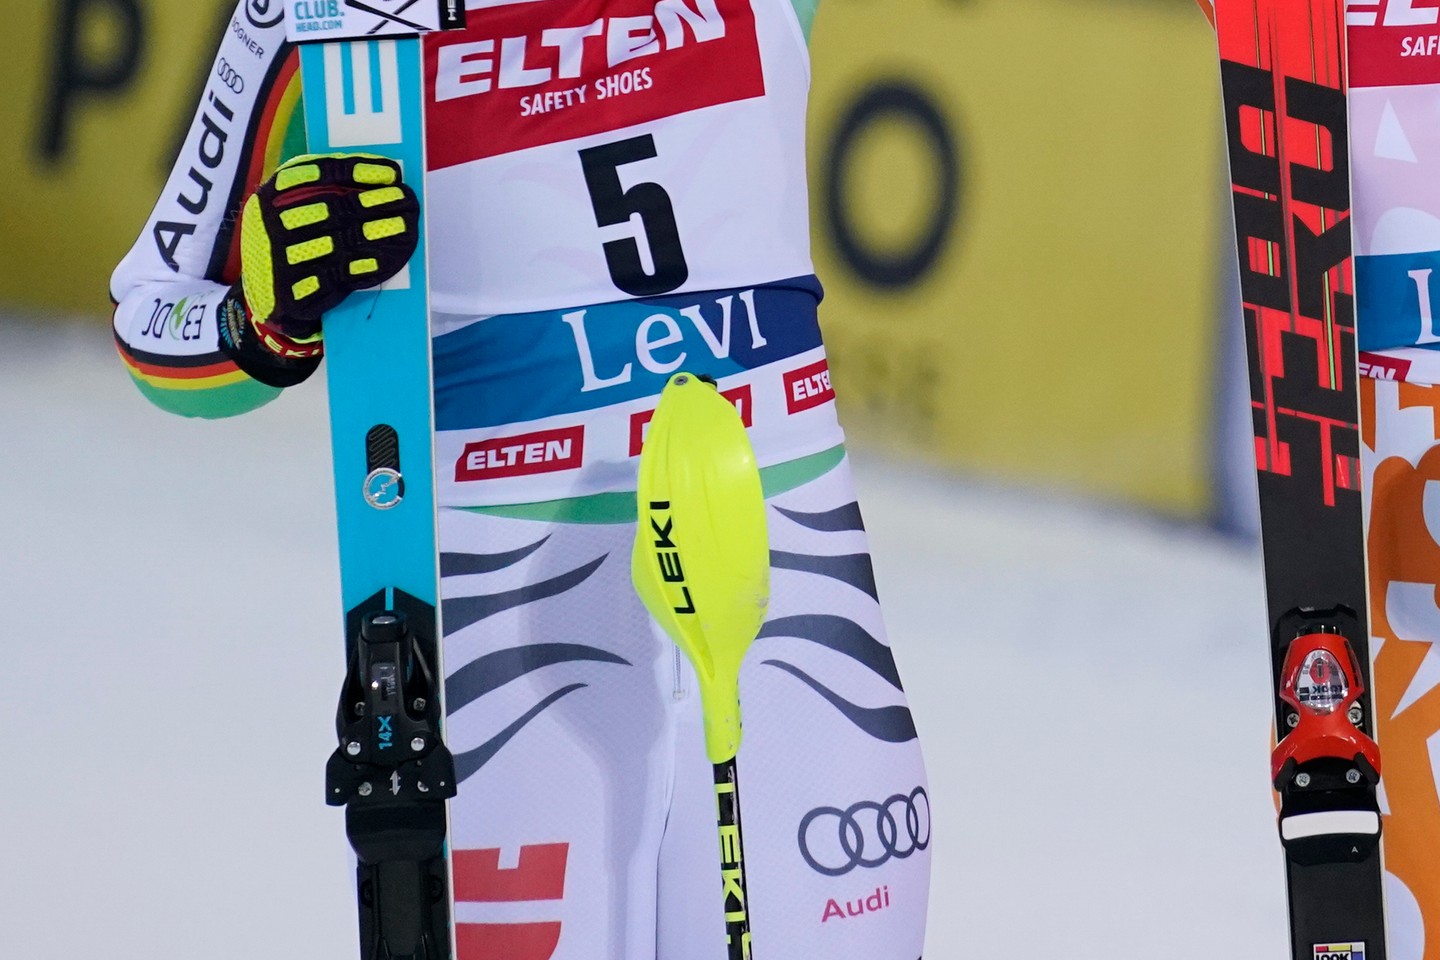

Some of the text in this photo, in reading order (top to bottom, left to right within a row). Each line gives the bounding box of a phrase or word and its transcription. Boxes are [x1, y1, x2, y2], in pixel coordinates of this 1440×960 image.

[295, 20, 343, 33] HEAD.COM
[519, 66, 654, 118] SAFETY SHOES
[152, 89, 235, 273] Audi
[578, 133, 689, 298] 5
[561, 289, 768, 393] Levi
[791, 370, 832, 403] ELTE
[466, 439, 573, 470] ELTEN
[650, 500, 697, 615] LEKI
[376, 715, 393, 751] 14X
[714, 781, 746, 923] LEKI
[1351, 845, 1359, 853] A
[820, 884, 892, 924] Audi
